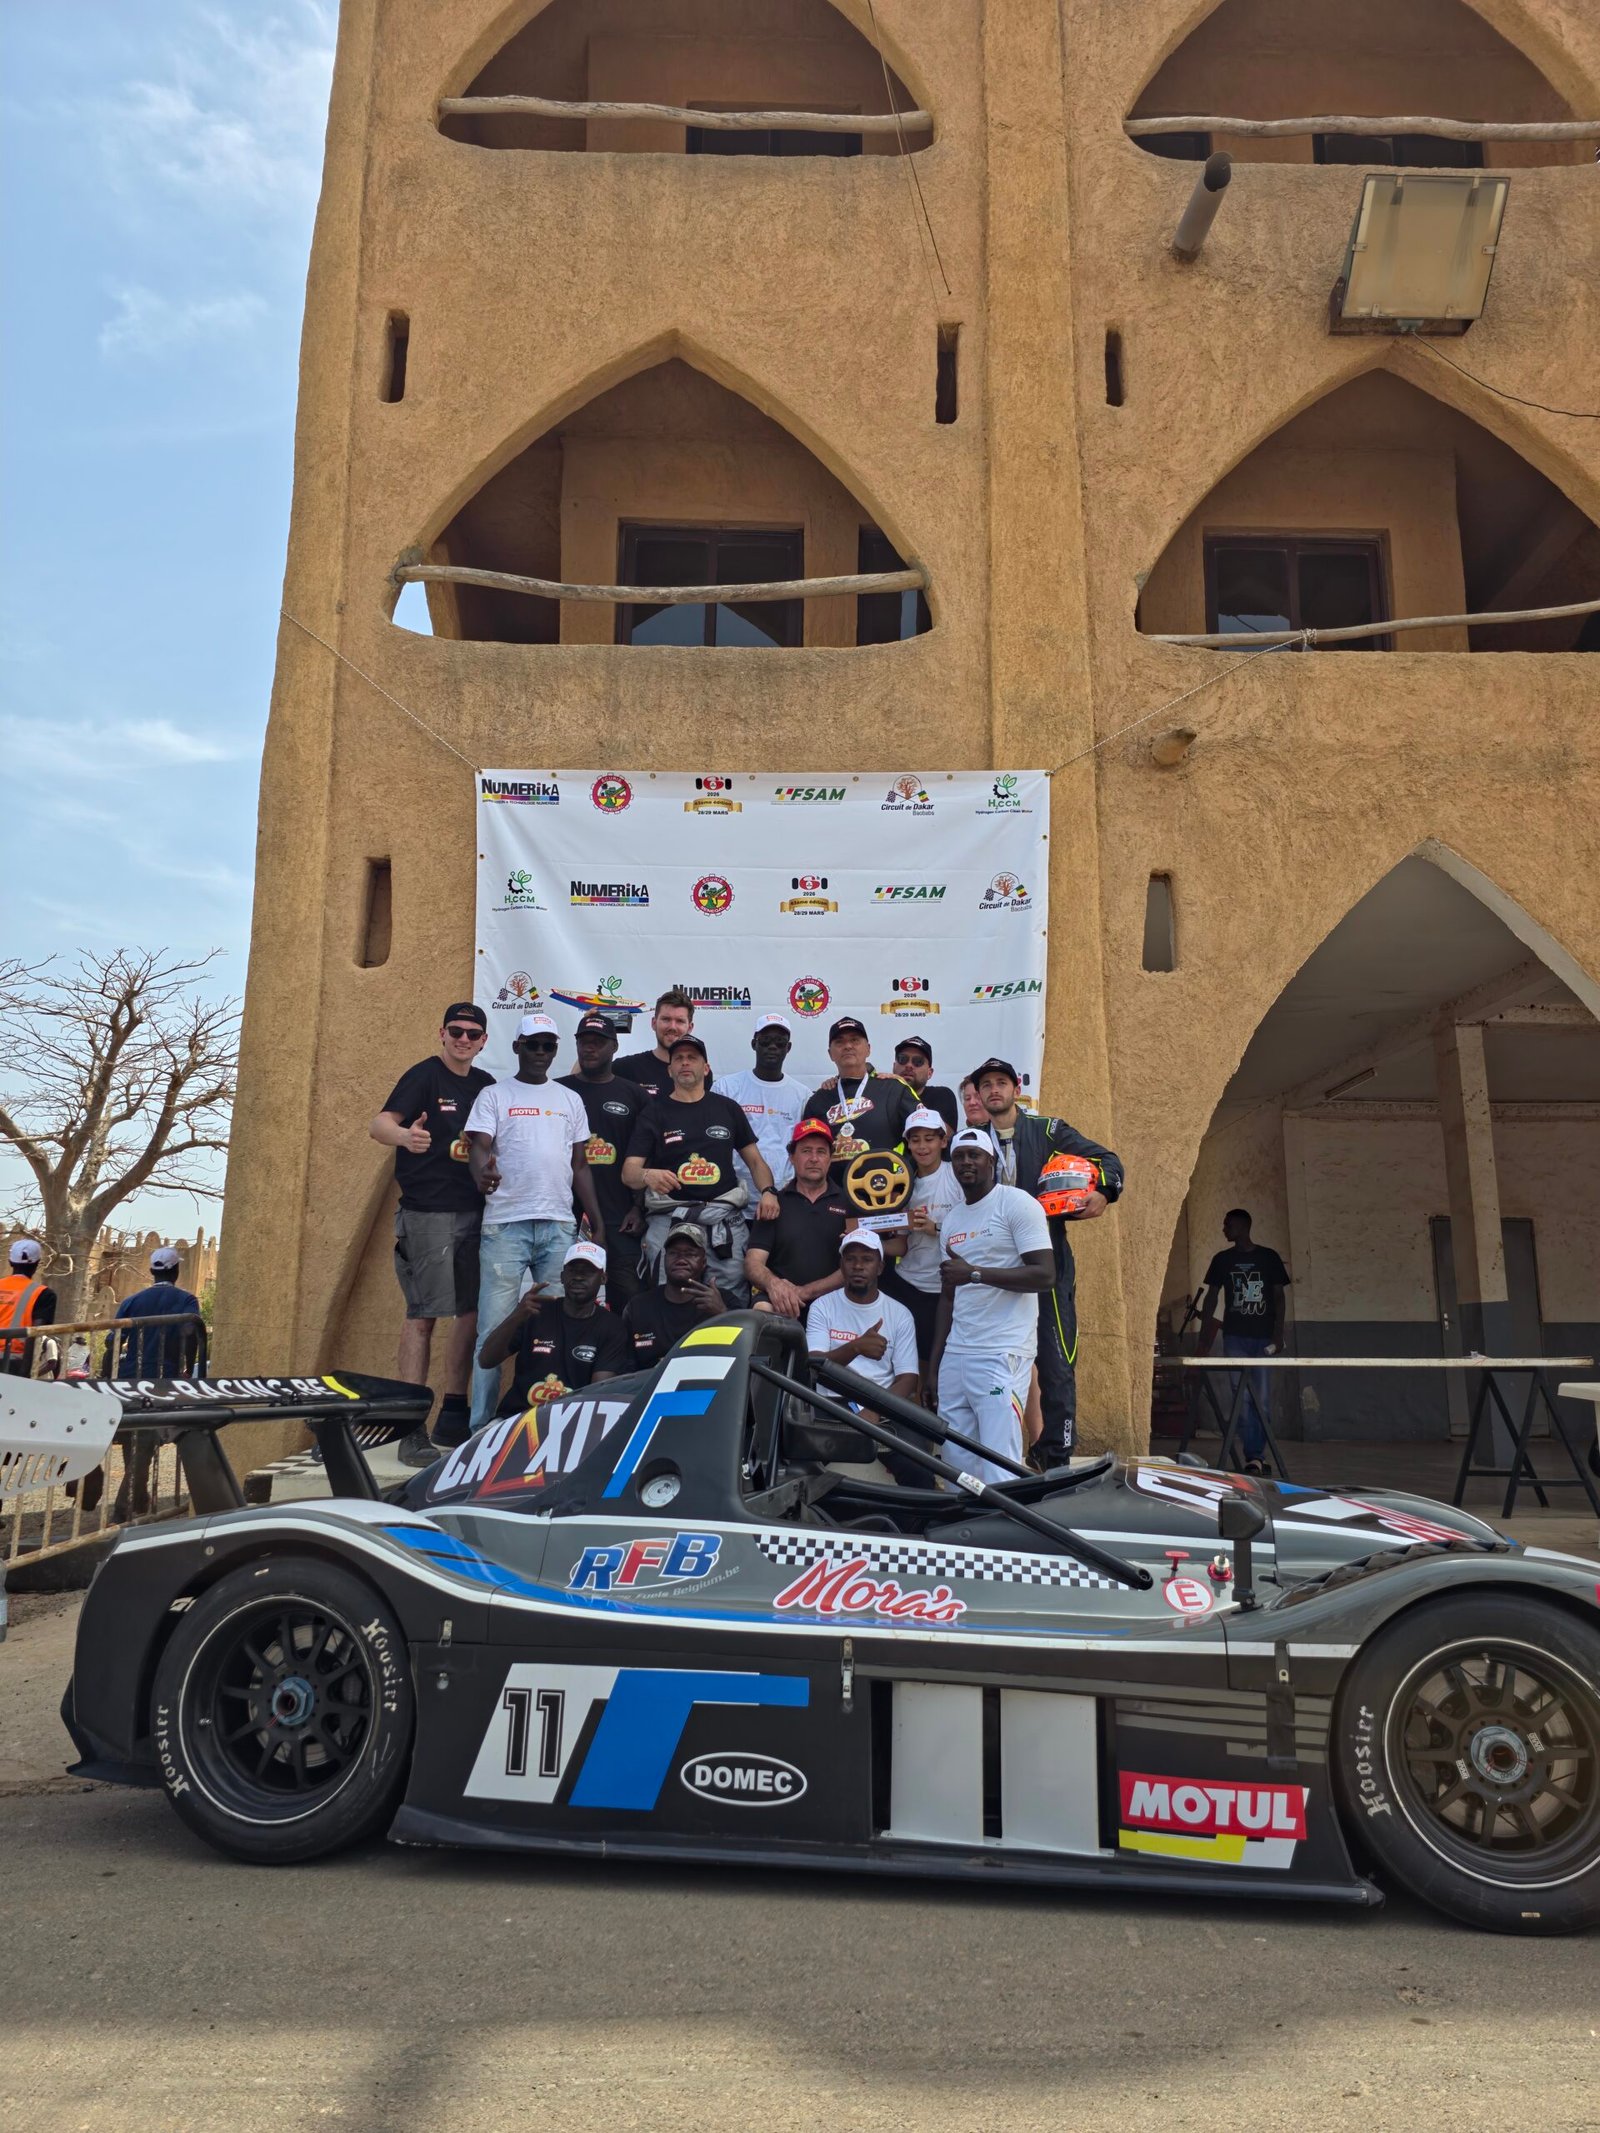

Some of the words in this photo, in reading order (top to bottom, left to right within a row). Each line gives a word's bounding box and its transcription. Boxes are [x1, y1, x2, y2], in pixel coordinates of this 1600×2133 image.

[791, 788, 847, 801] FSAM
[881, 803, 904, 811] Circuit
[891, 886, 947, 899] FSAM
[979, 902, 1003, 910] Circuit
[1011, 897, 1032, 906] Dakar
[991, 981, 1043, 997] FSAM
[492, 1001, 516, 1010] Circuit
[524, 1001, 544, 1009] Dakar
[681, 1165, 715, 1181] Crax
[568, 1532, 722, 1591] RFB
[673, 1564, 740, 1596] Belgium.be
[774, 1557, 967, 1621] Mora's
[1174, 1584, 1203, 1607] E
[503, 1688, 566, 1777] 11
[1350, 1705, 1391, 1817] Hoosier
[694, 1764, 792, 1794] DOMEC
[1128, 1780, 1297, 1831] MOTUL
